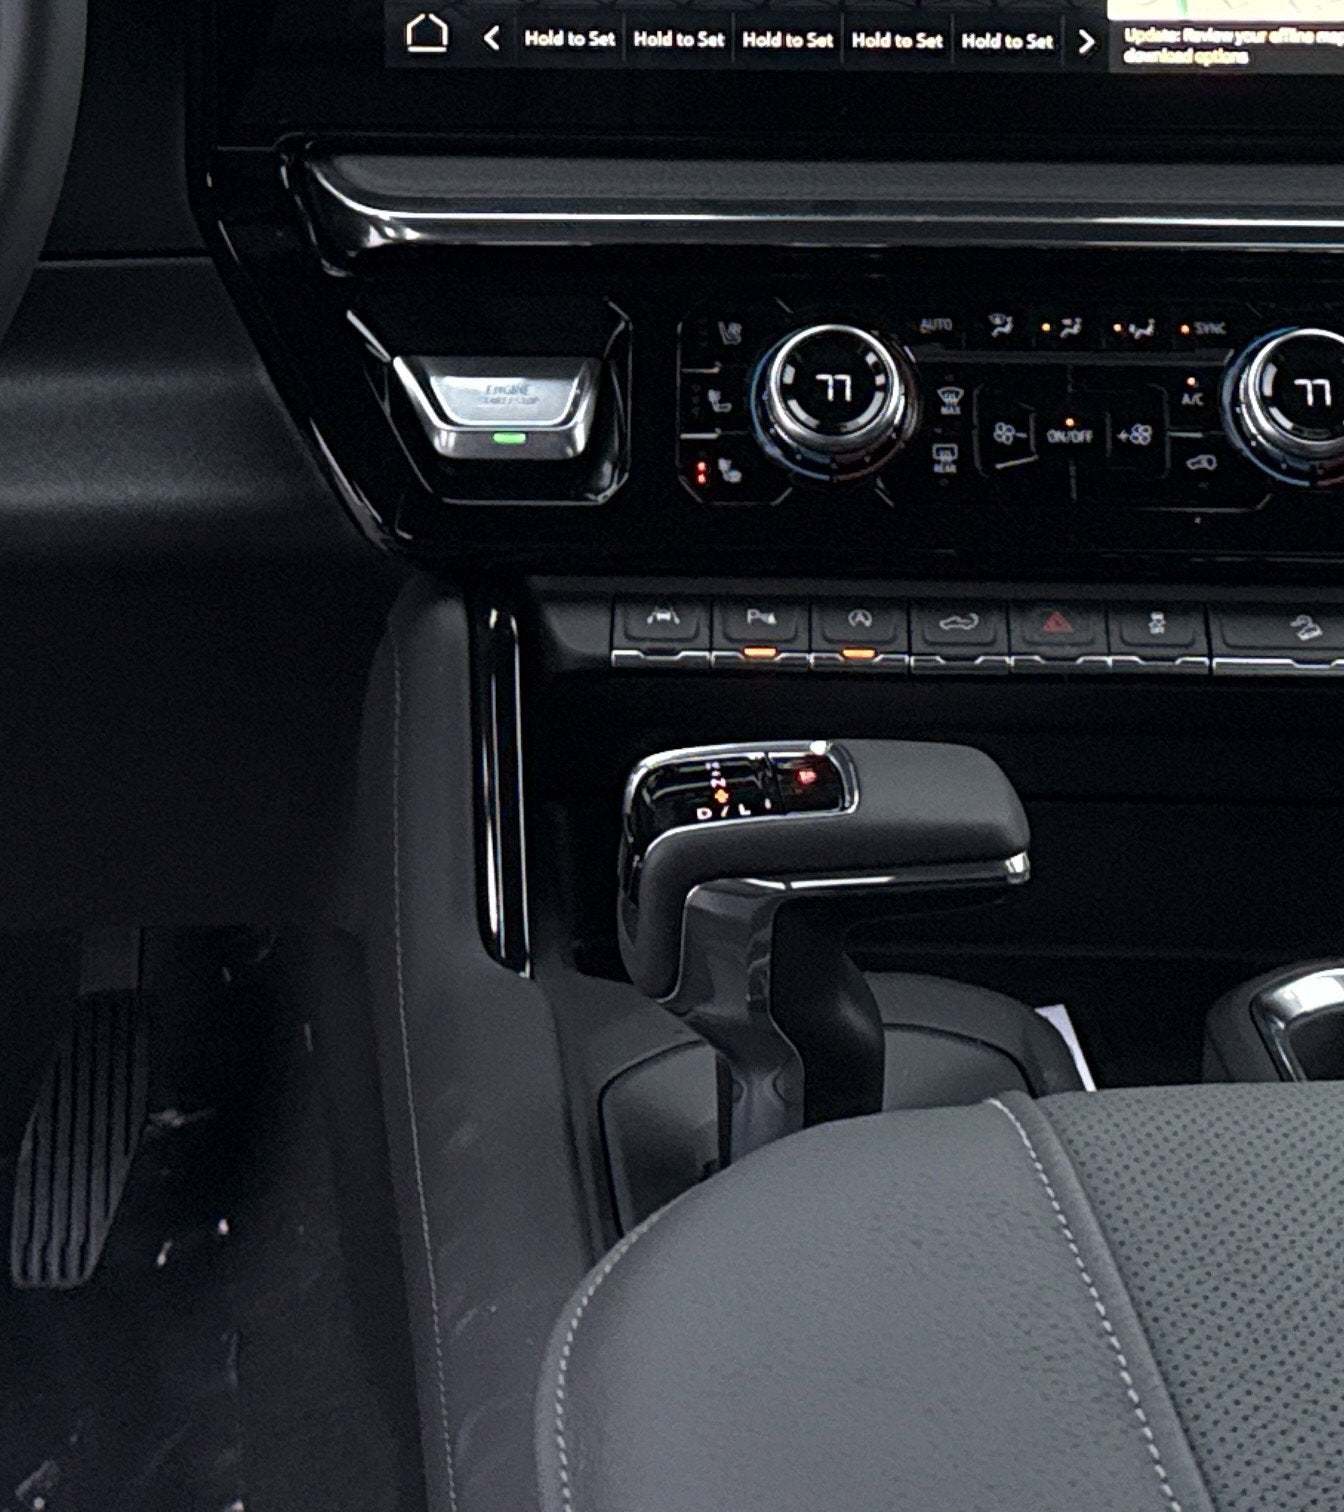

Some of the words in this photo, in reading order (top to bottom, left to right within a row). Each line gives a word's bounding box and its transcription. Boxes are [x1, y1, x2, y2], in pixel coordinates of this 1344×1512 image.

[525, 29, 564, 47] Hold
[568, 31, 585, 47] to
[589, 29, 616, 47] Set
[633, 30, 673, 48] Hold
[676, 32, 695, 48] to
[697, 30, 726, 48] Set
[743, 30, 782, 48] Hold
[785, 32, 804, 48] to
[806, 30, 834, 48] Set
[852, 31, 891, 49] Hold
[895, 33, 913, 49] to
[916, 31, 944, 49] Set
[962, 32, 1002, 50] Hold
[1005, 34, 1023, 50] to
[1026, 32, 1054, 50] Set
[1235, 31, 1267, 45] your
[920, 318, 953, 331] AUTO
[1194, 321, 1227, 335] SYNC
[815, 373, 852, 403] 77
[1293, 378, 1332, 407] 77
[1181, 392, 1204, 406] A/C
[1047, 429, 1093, 443] ON/OFF
[696, 807, 712, 820] D
